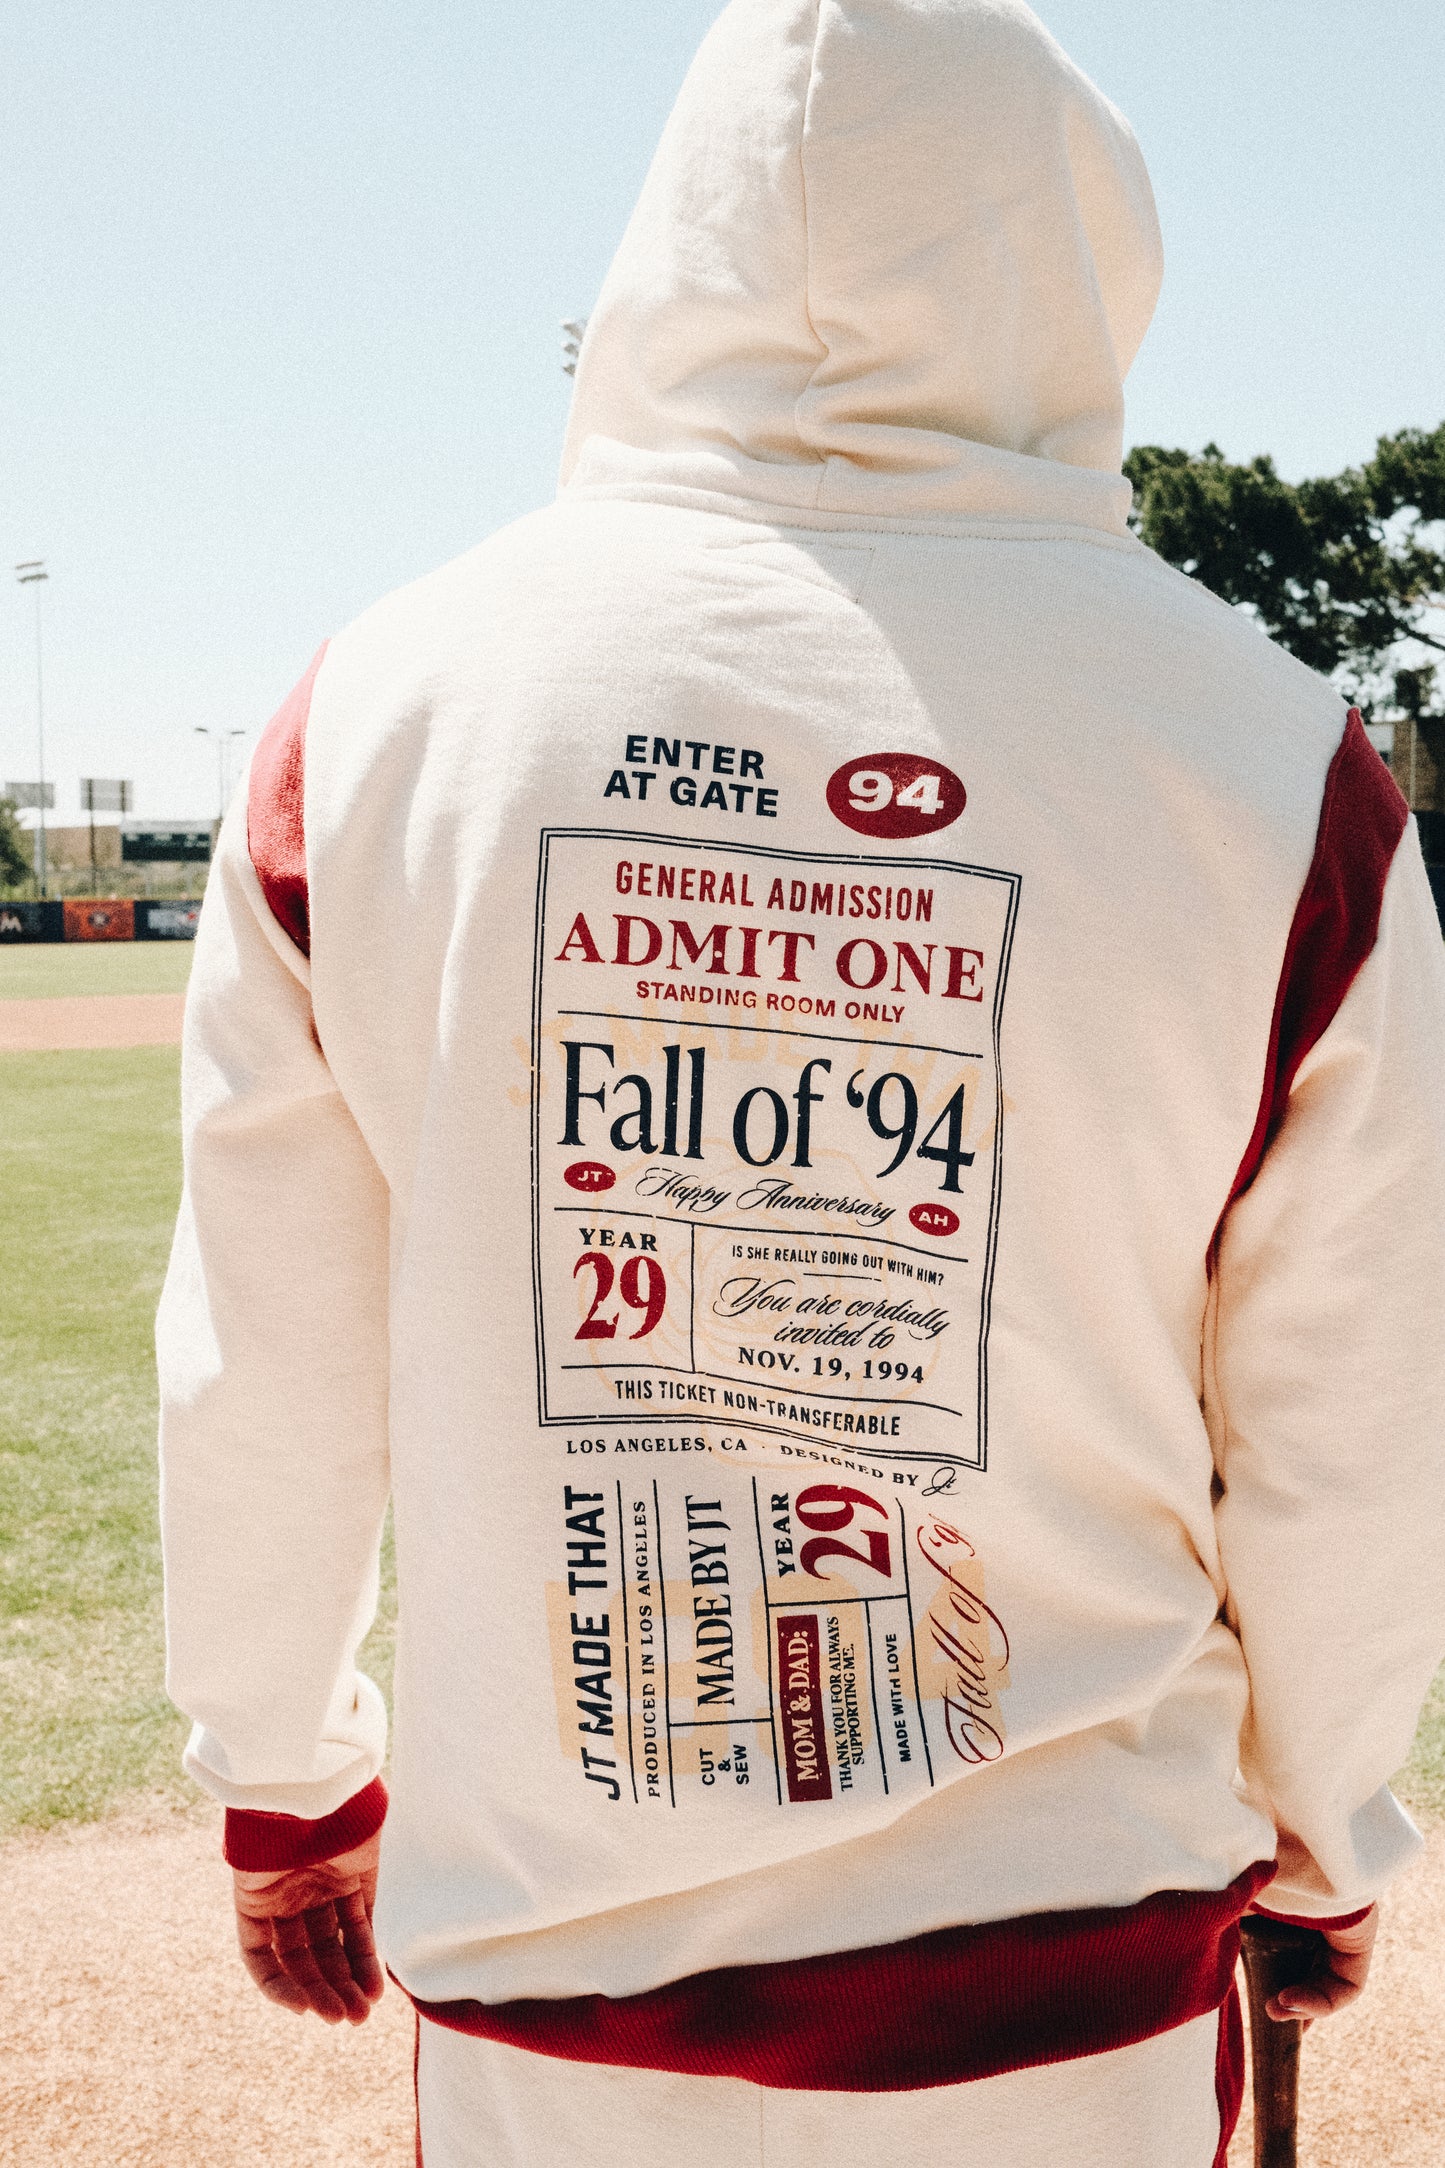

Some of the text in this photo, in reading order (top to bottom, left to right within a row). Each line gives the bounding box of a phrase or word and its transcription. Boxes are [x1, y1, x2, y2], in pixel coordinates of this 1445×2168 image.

[626, 735, 764, 779] ENTER
[604, 770, 778, 817] AT GATE
[847, 769, 945, 816] 94
[617, 861, 933, 921] GENERAL ADMISSION
[555, 913, 983, 1002] ADMIT ONE
[637, 981, 905, 1023] STANDING ROOM ONLY
[557, 1041, 975, 1193] Fall of ‘94
[577, 1170, 603, 1183] JT
[636, 1168, 896, 1227] Happy Anniversary
[579, 1228, 657, 1251] YEAR
[918, 1211, 949, 1227] AH
[733, 1246, 944, 1285] IS SHE REALLY GOING OUT WITH HIM?
[574, 1252, 666, 1339] 29
[713, 1277, 950, 1341] You are cordially
[774, 1321, 896, 1350] invited to
[739, 1347, 923, 1383] NOV. 19, 1994
[615, 1380, 900, 1435] THIS TICKET NON-TRANSFERABLE
[567, 1440, 606, 1453] LOS
[615, 1438, 712, 1452] ANGELES,
[721, 1438, 747, 1450] CA
[781, 1445, 883, 1478] DESIGNED
[893, 1473, 918, 1486] BY
[771, 1493, 795, 1578] YEAR
[795, 1485, 891, 1580] 29
[928, 1512, 977, 1558] ‘9
[685, 1495, 734, 1707] MADE BY JT
[564, 1486, 620, 1800] JT MADE THAT
[634, 1502, 660, 1797] PRODUCED IN LOS ANGELES
[786, 1631, 822, 1784] MOM & DAD:
[827, 1617, 853, 1792] THANK YOU FOR ALWAYS
[843, 1644, 864, 1765] SUPPORTING ME.
[886, 1634, 911, 1762] MADE WITH LOVE
[699, 1748, 715, 1785] CUT
[718, 1759, 731, 1772] &
[733, 1745, 749, 1784] SEW
